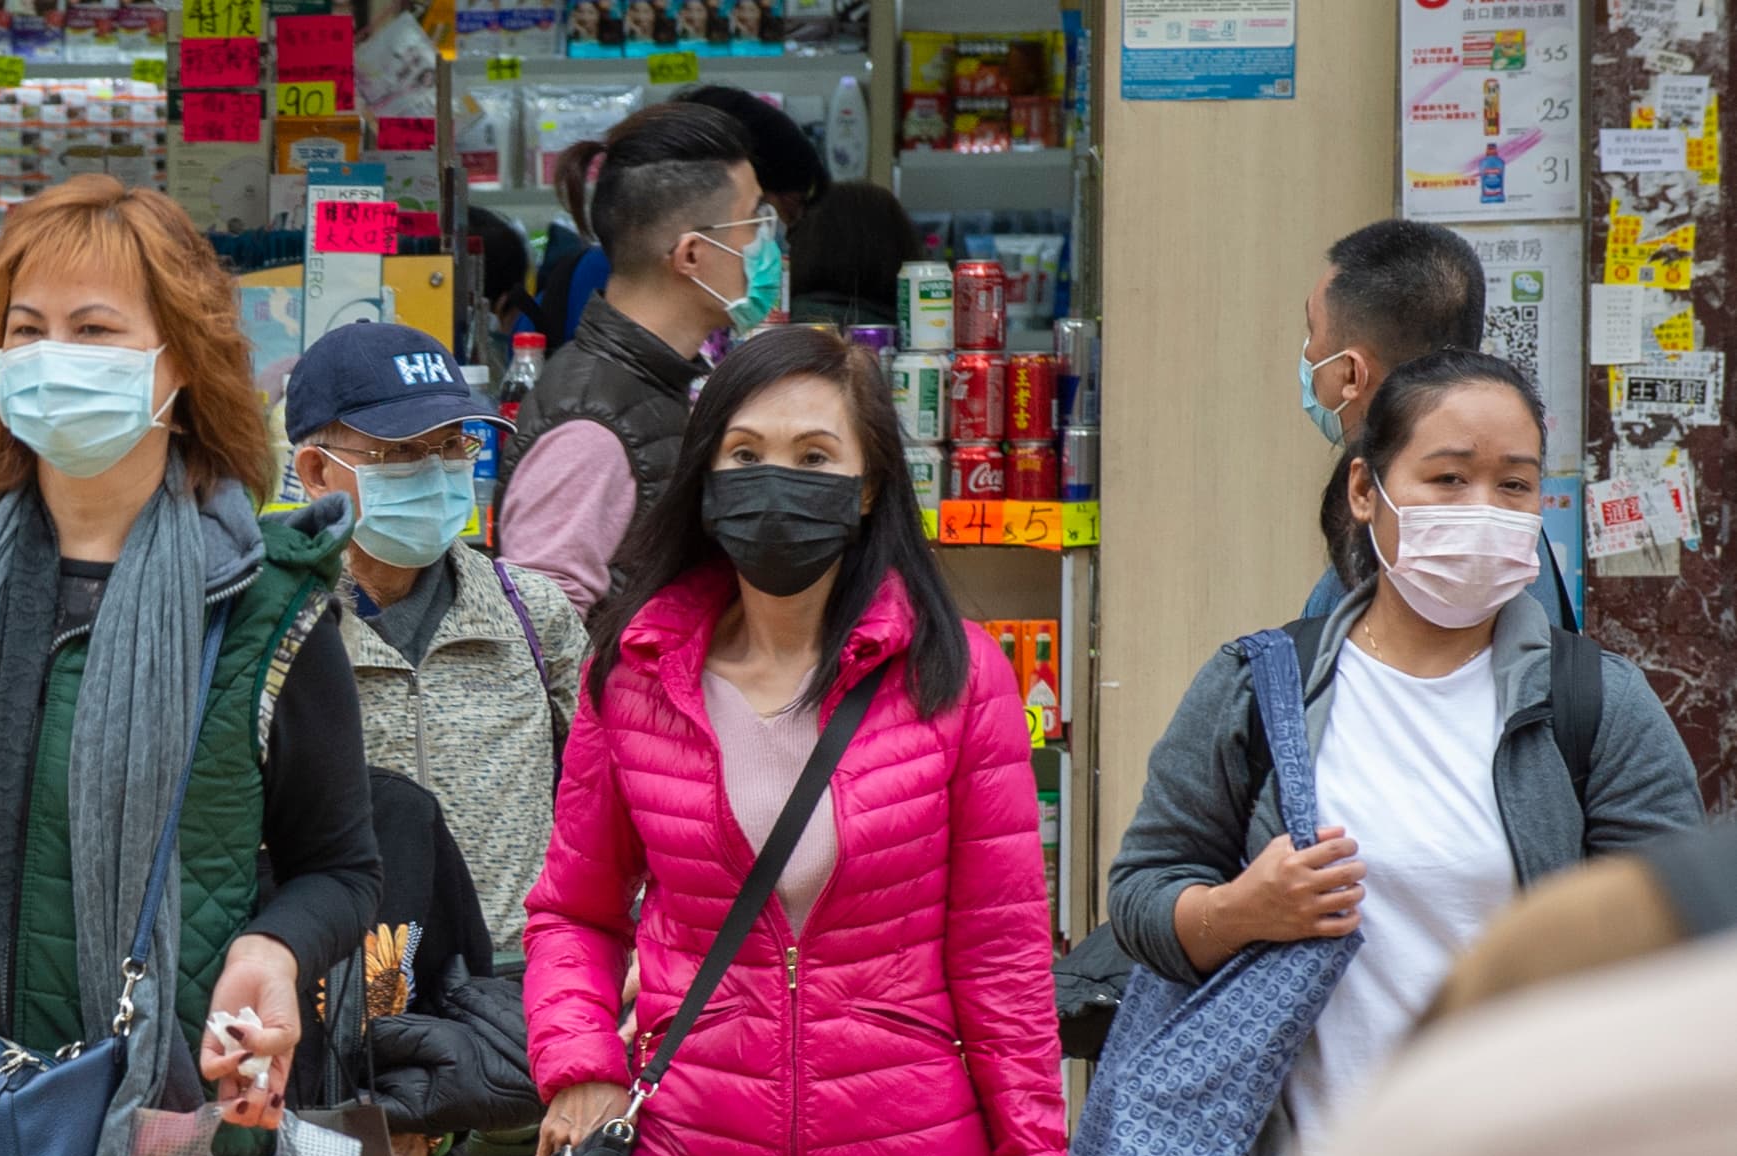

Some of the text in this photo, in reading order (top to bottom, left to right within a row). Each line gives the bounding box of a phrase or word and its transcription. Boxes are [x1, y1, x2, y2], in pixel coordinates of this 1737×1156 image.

[1462, 4, 1566, 21] 由口腔開始抗菌
[1540, 97, 1573, 122] 25
[1542, 156, 1571, 184] 31
[339, 189, 382, 201] KF94
[1474, 239, 1543, 262] 信藥房
[392, 352, 454, 386] HH
[1013, 368, 1032, 430] 王老吉
